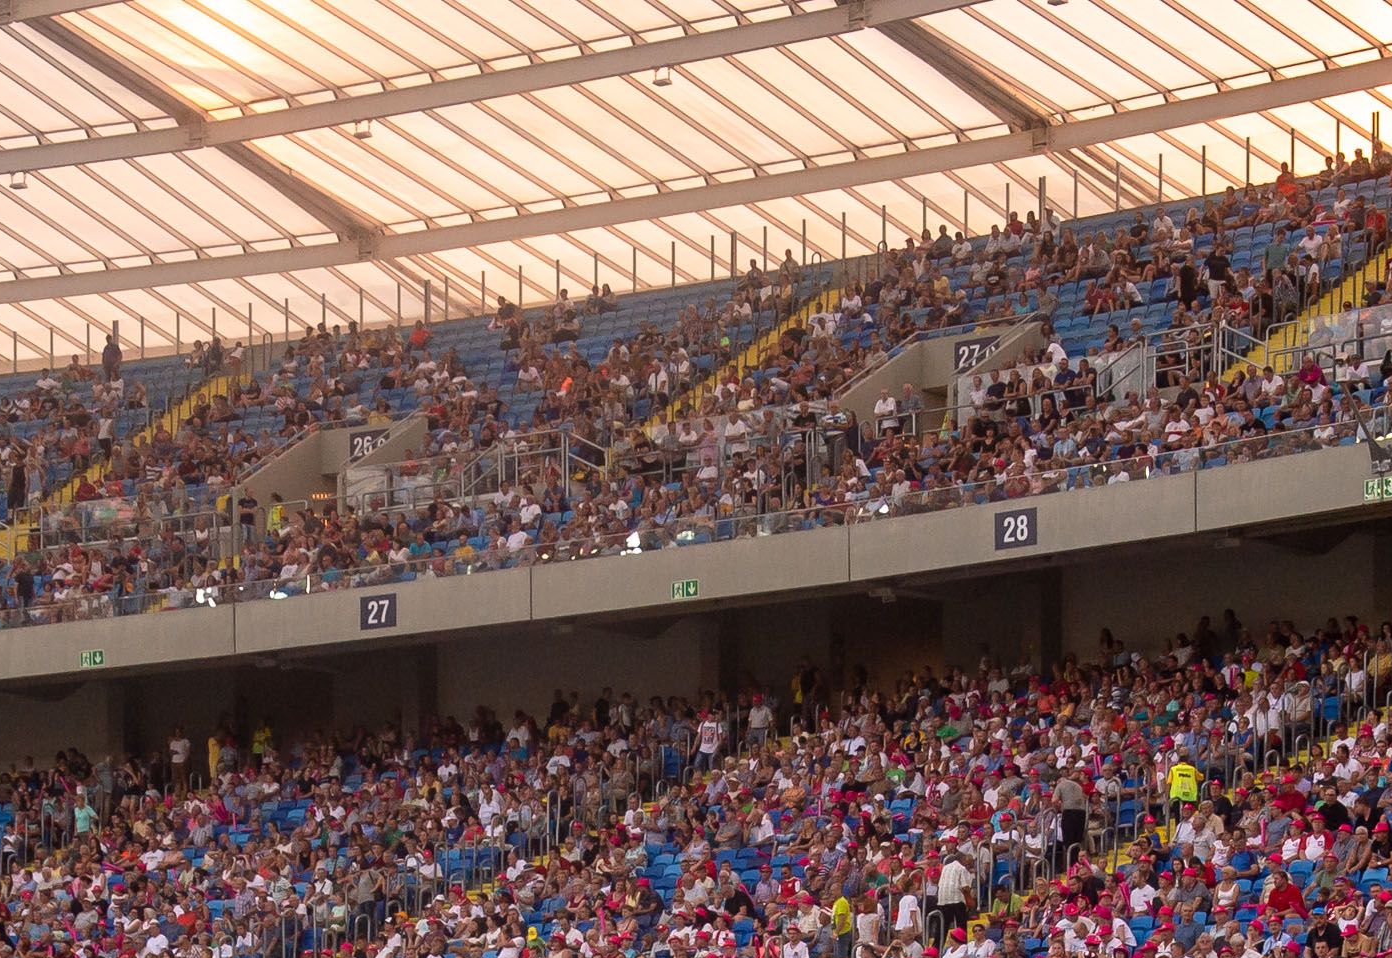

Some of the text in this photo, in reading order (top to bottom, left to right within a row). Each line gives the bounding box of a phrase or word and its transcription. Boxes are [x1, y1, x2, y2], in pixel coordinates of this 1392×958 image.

[959, 344, 980, 368] 27
[1003, 515, 1028, 543] 28
[367, 599, 389, 624] 27
